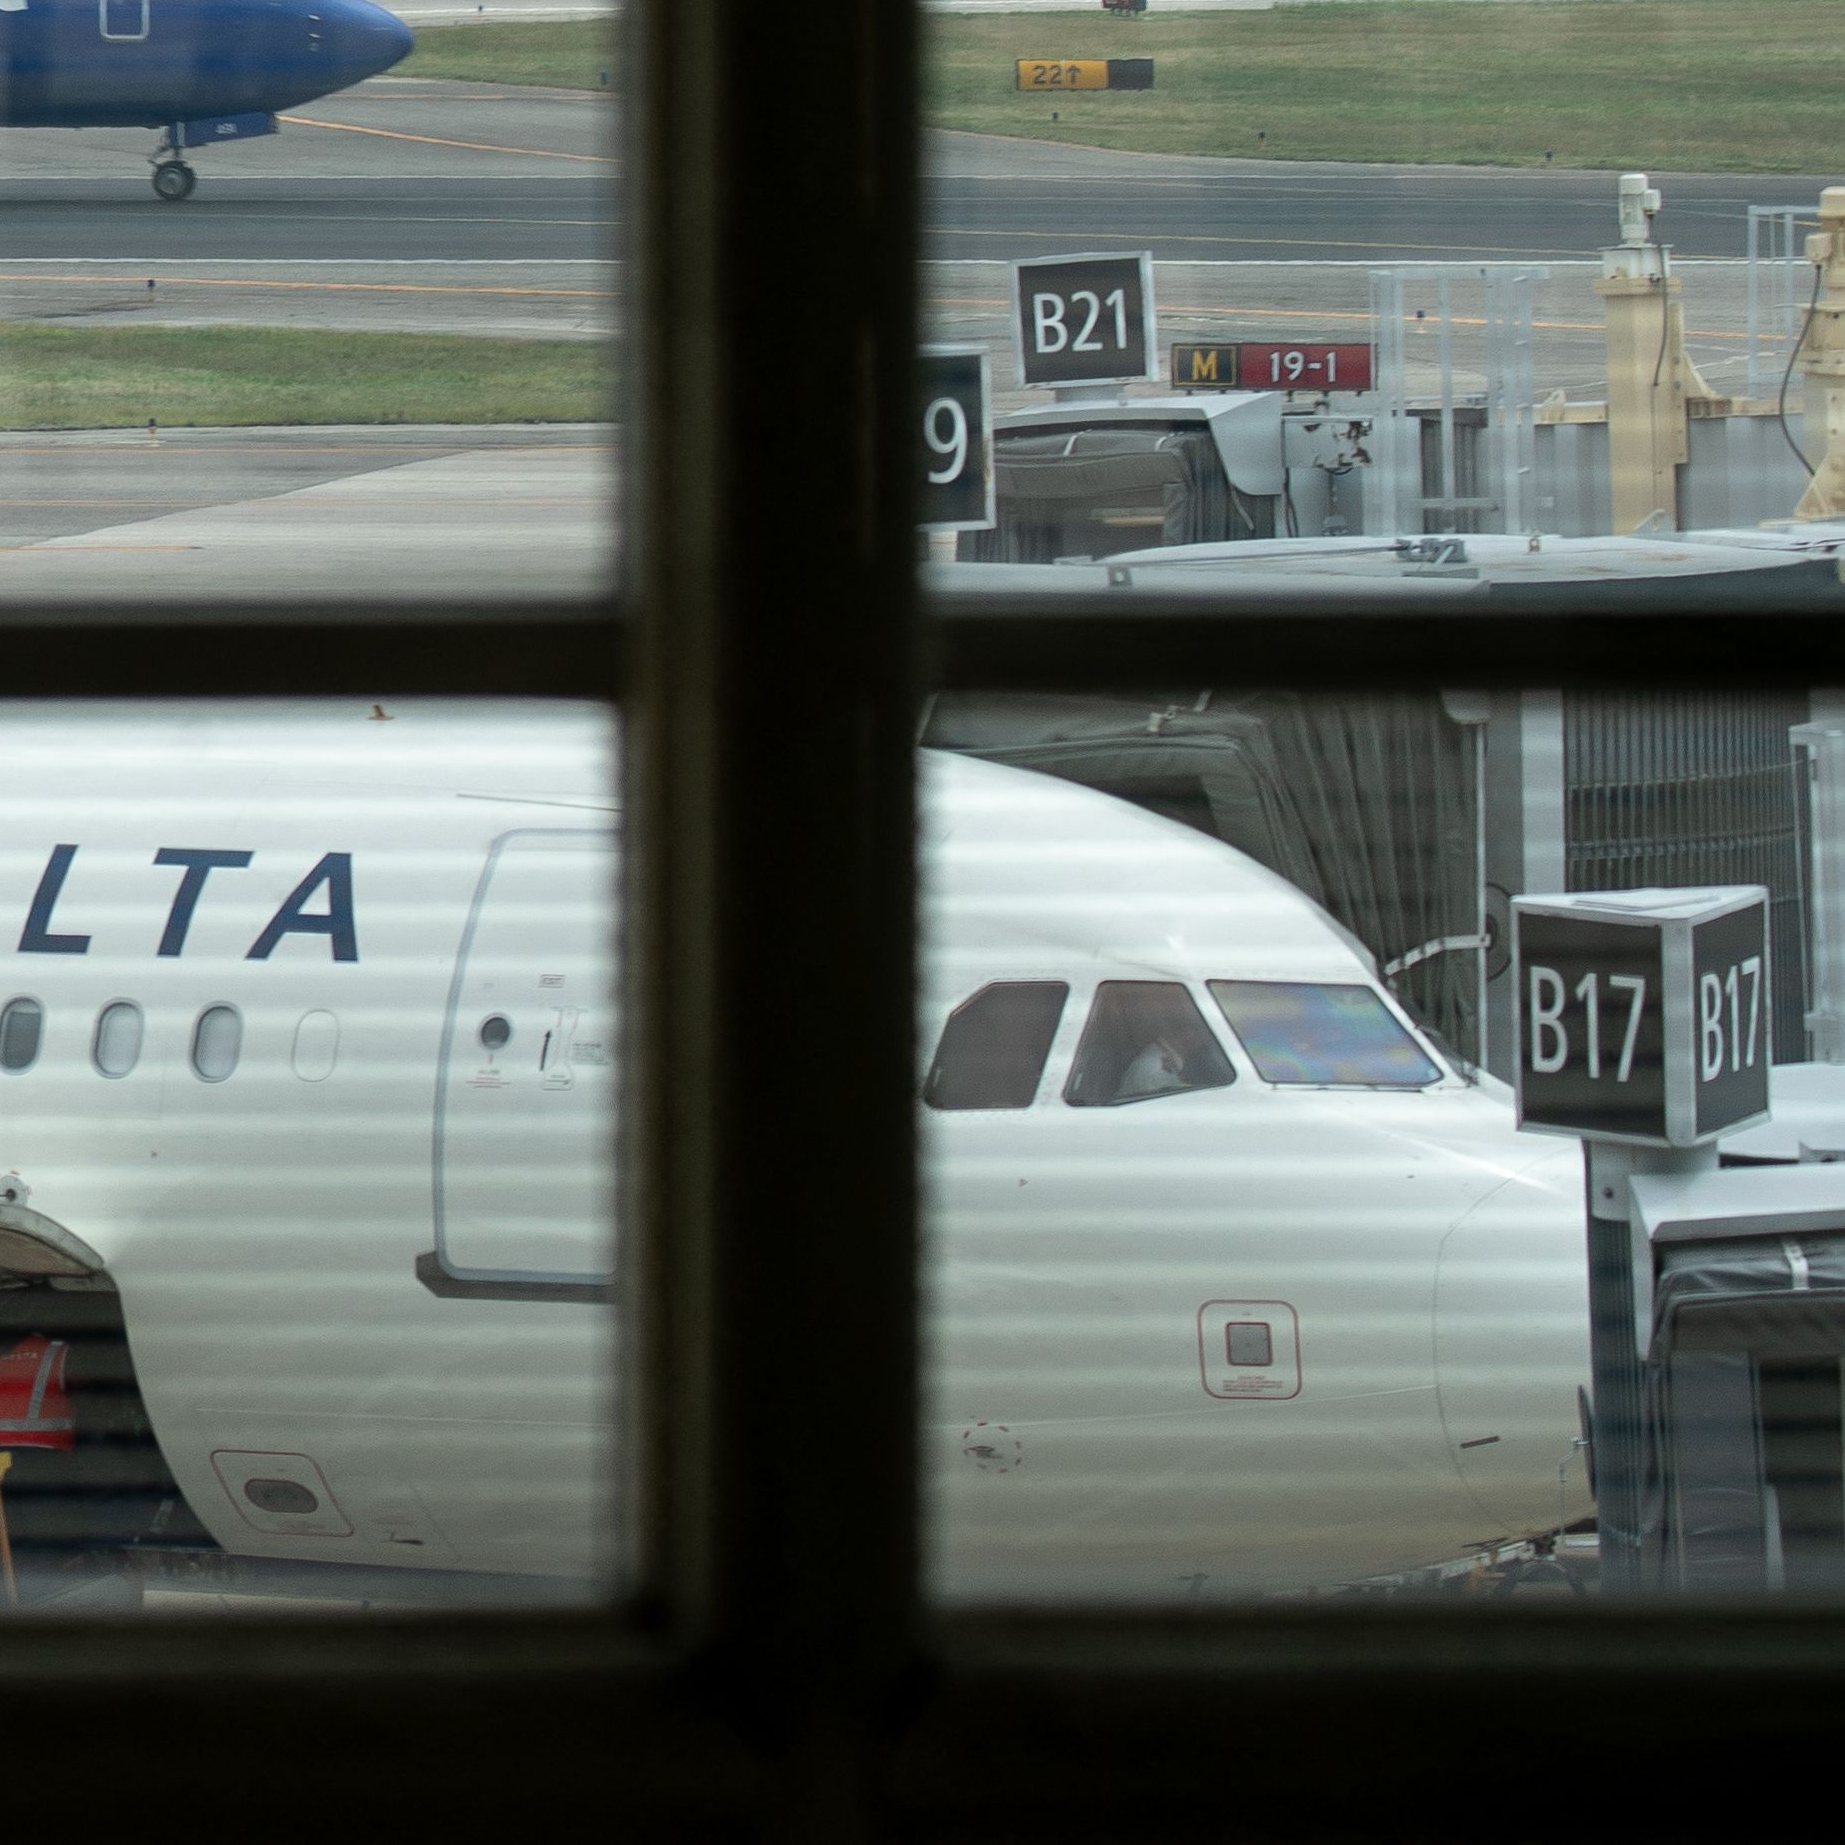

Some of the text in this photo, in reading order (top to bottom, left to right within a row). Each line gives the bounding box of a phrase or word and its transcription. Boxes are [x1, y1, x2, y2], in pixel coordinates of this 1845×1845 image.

[1032, 64, 1062, 86] 22
[1032, 288, 1129, 355] B21
[1191, 348, 1337, 385] M 19-1
[1529, 964, 1646, 1083] B17
[1699, 955, 1761, 1084] B17
